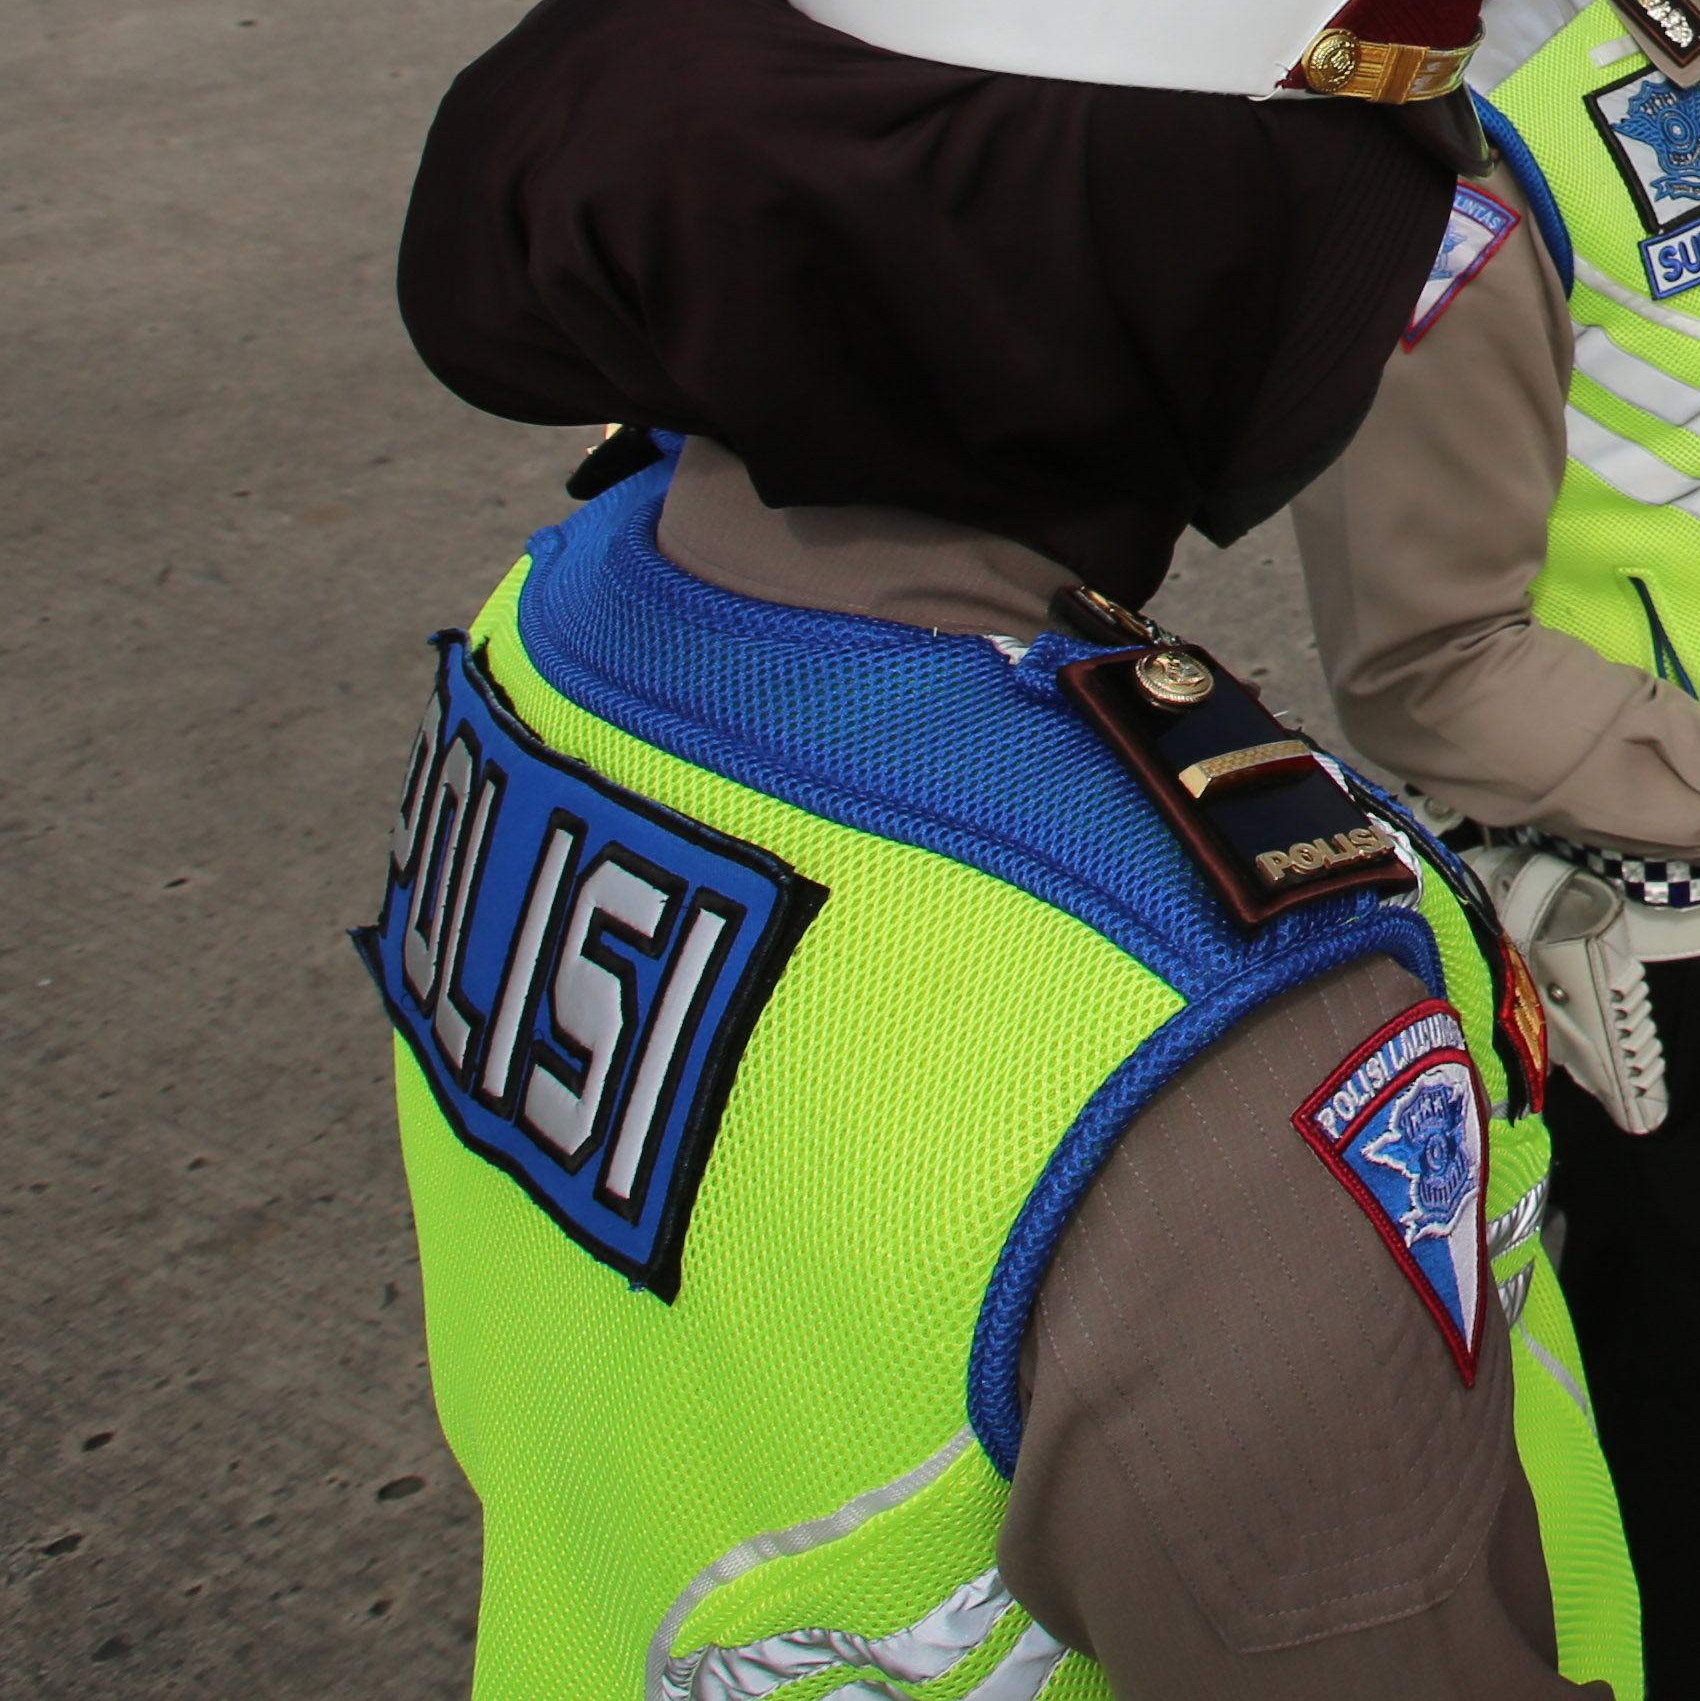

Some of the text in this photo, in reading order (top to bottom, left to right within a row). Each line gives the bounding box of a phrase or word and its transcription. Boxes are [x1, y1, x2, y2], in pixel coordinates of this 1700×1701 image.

[1255, 824, 1396, 885] POLISI
[388, 687, 734, 1212] POLISI
[1316, 1049, 1392, 1140] POLISI
